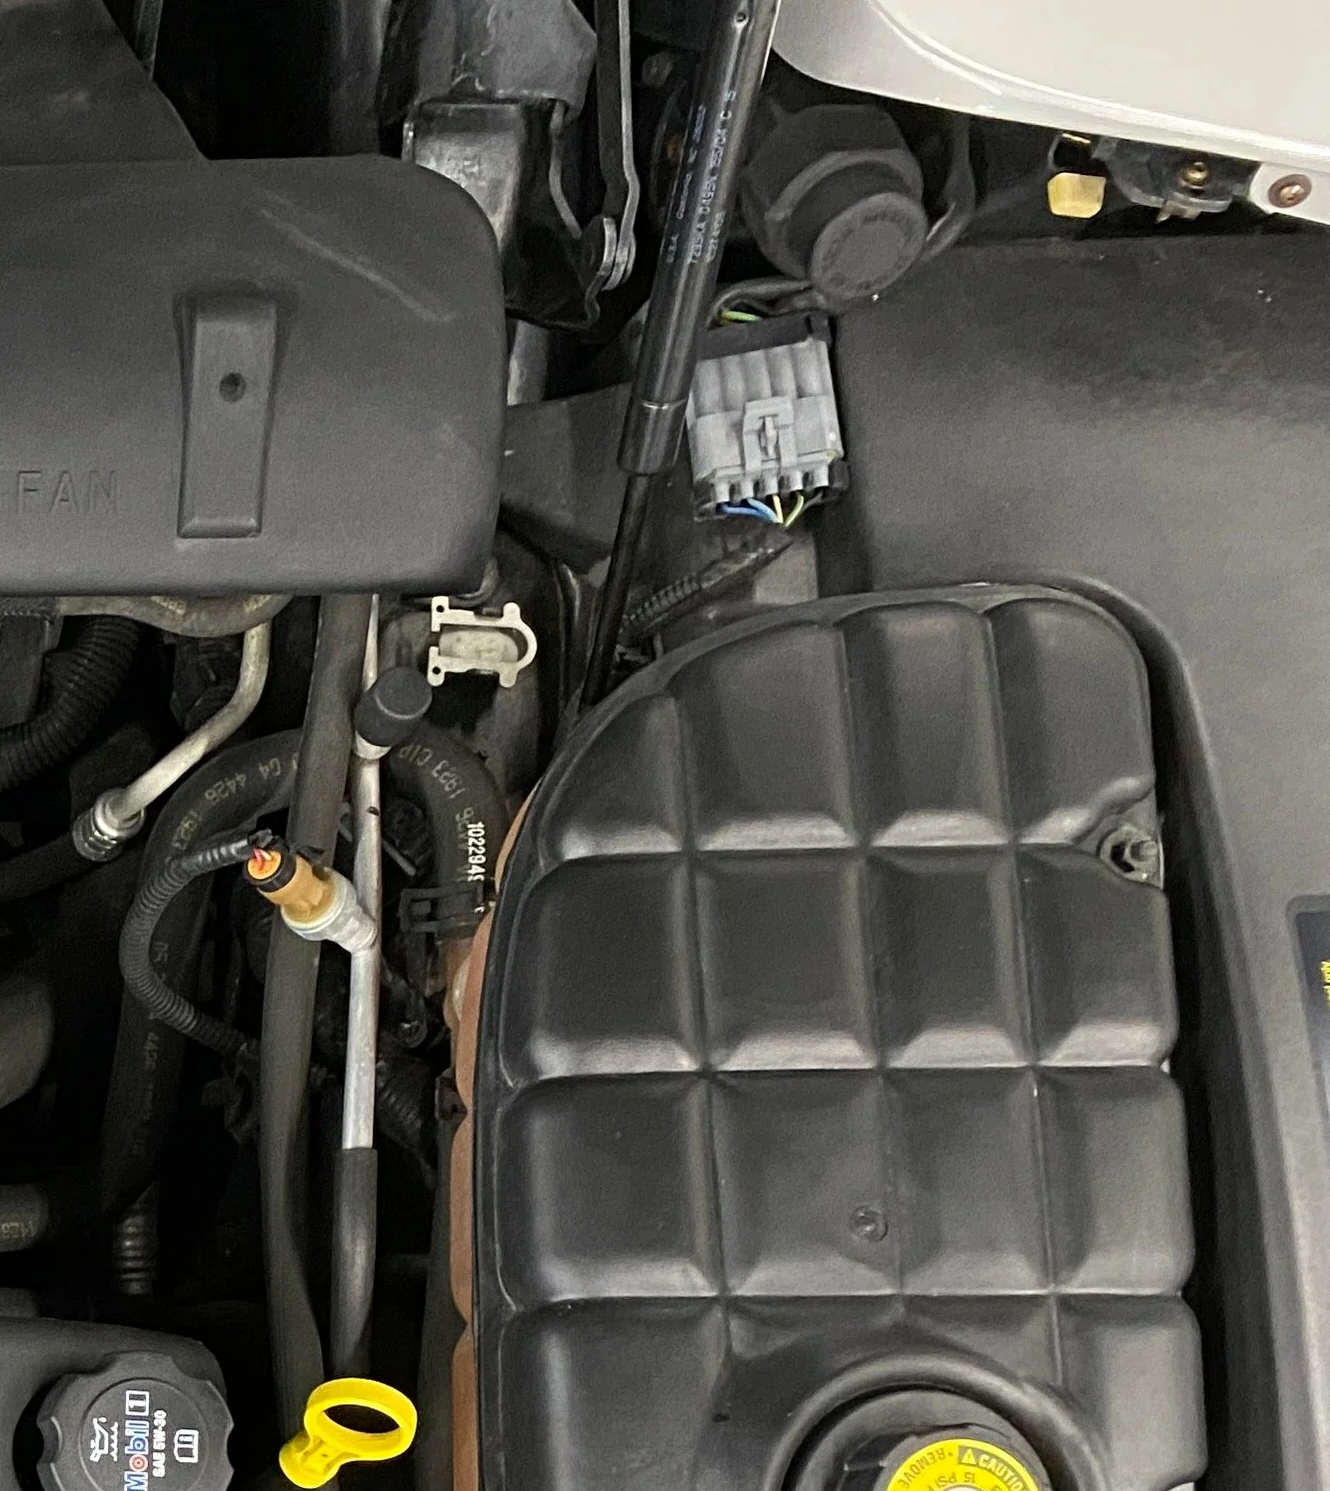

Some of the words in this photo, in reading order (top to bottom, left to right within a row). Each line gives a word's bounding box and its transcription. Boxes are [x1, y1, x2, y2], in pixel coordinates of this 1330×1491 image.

[16, 470, 117, 515] FAN
[152, 1409, 166, 1450] 5W-30
[152, 1452, 165, 1477] SAE
[900, 1447, 946, 1489] REMOVE
[936, 1472, 957, 1488] PSI
[963, 1471, 976, 1483] 15
